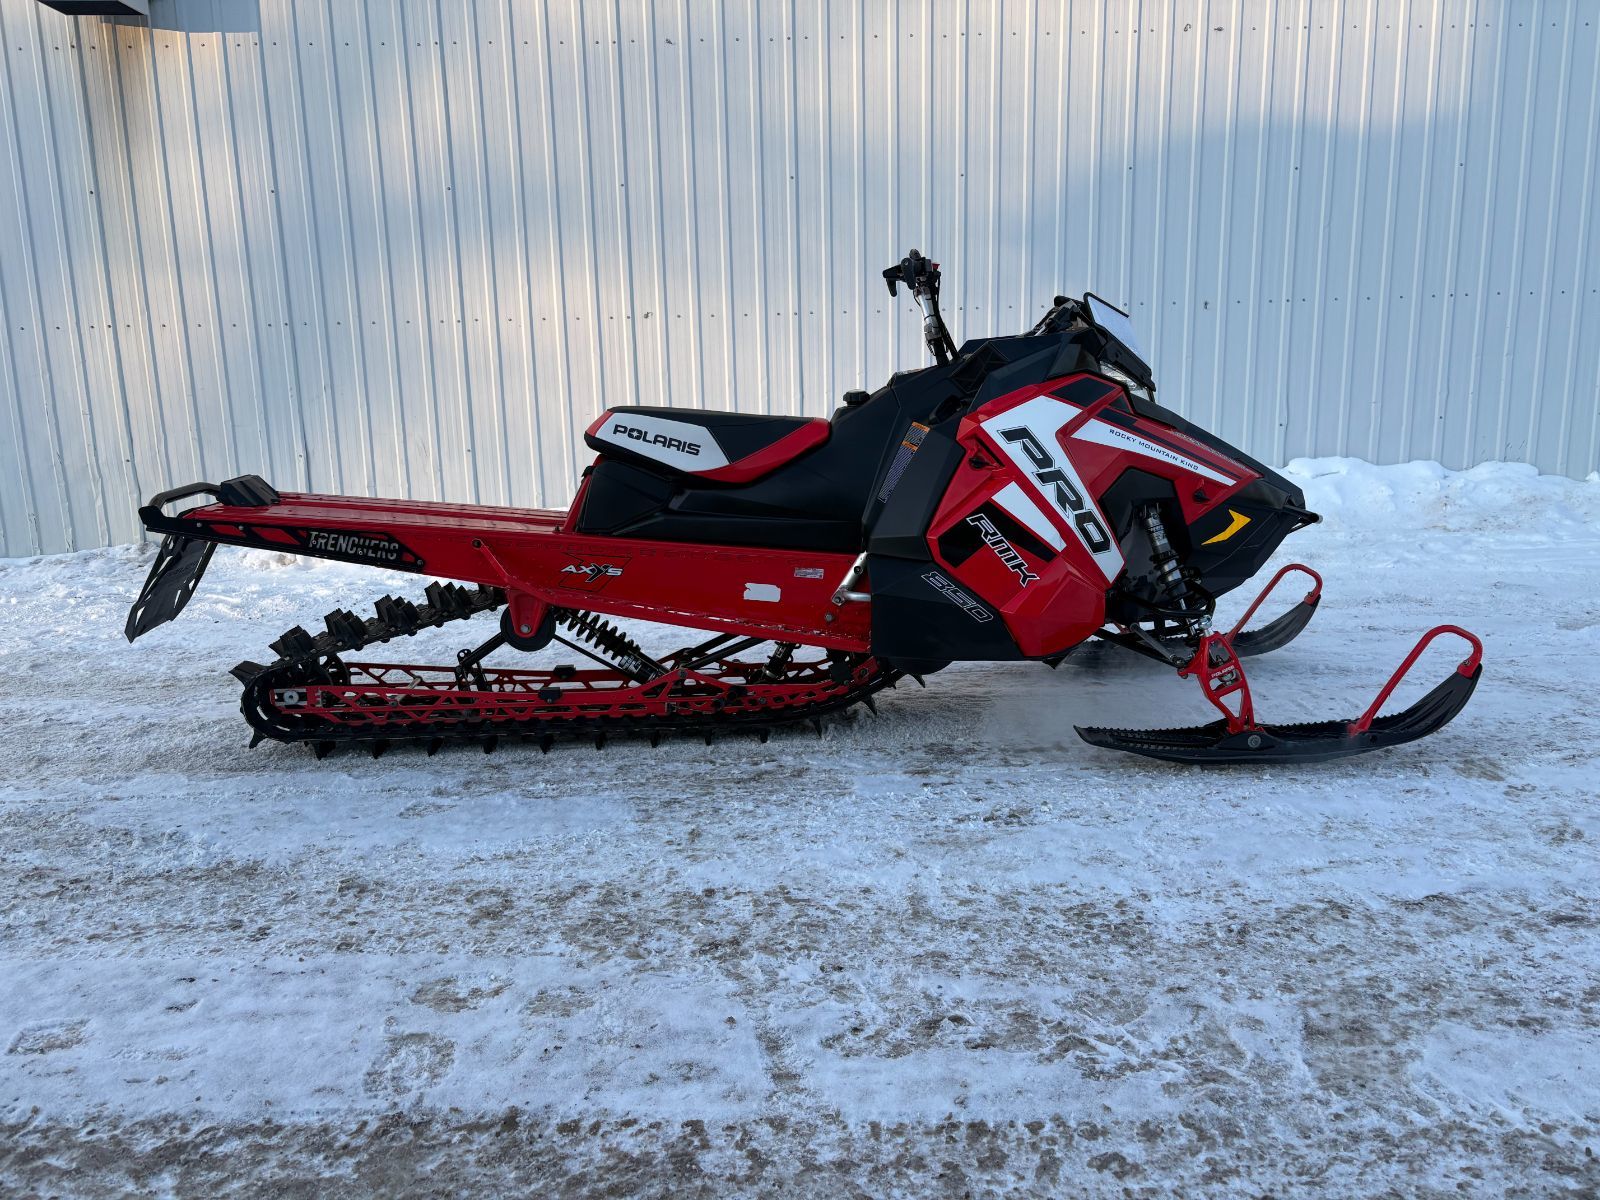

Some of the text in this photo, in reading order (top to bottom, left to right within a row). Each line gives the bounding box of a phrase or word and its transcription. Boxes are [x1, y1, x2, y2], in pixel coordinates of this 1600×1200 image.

[612, 424, 702, 456] POLARIS
[1109, 428, 1137, 443] ROCKY
[1138, 440, 1179, 462] MOUNTAIN
[997, 425, 1112, 556] PRO
[966, 513, 1041, 588] RMK
[561, 563, 623, 583] AXYS
[921, 571, 994, 623] 850
